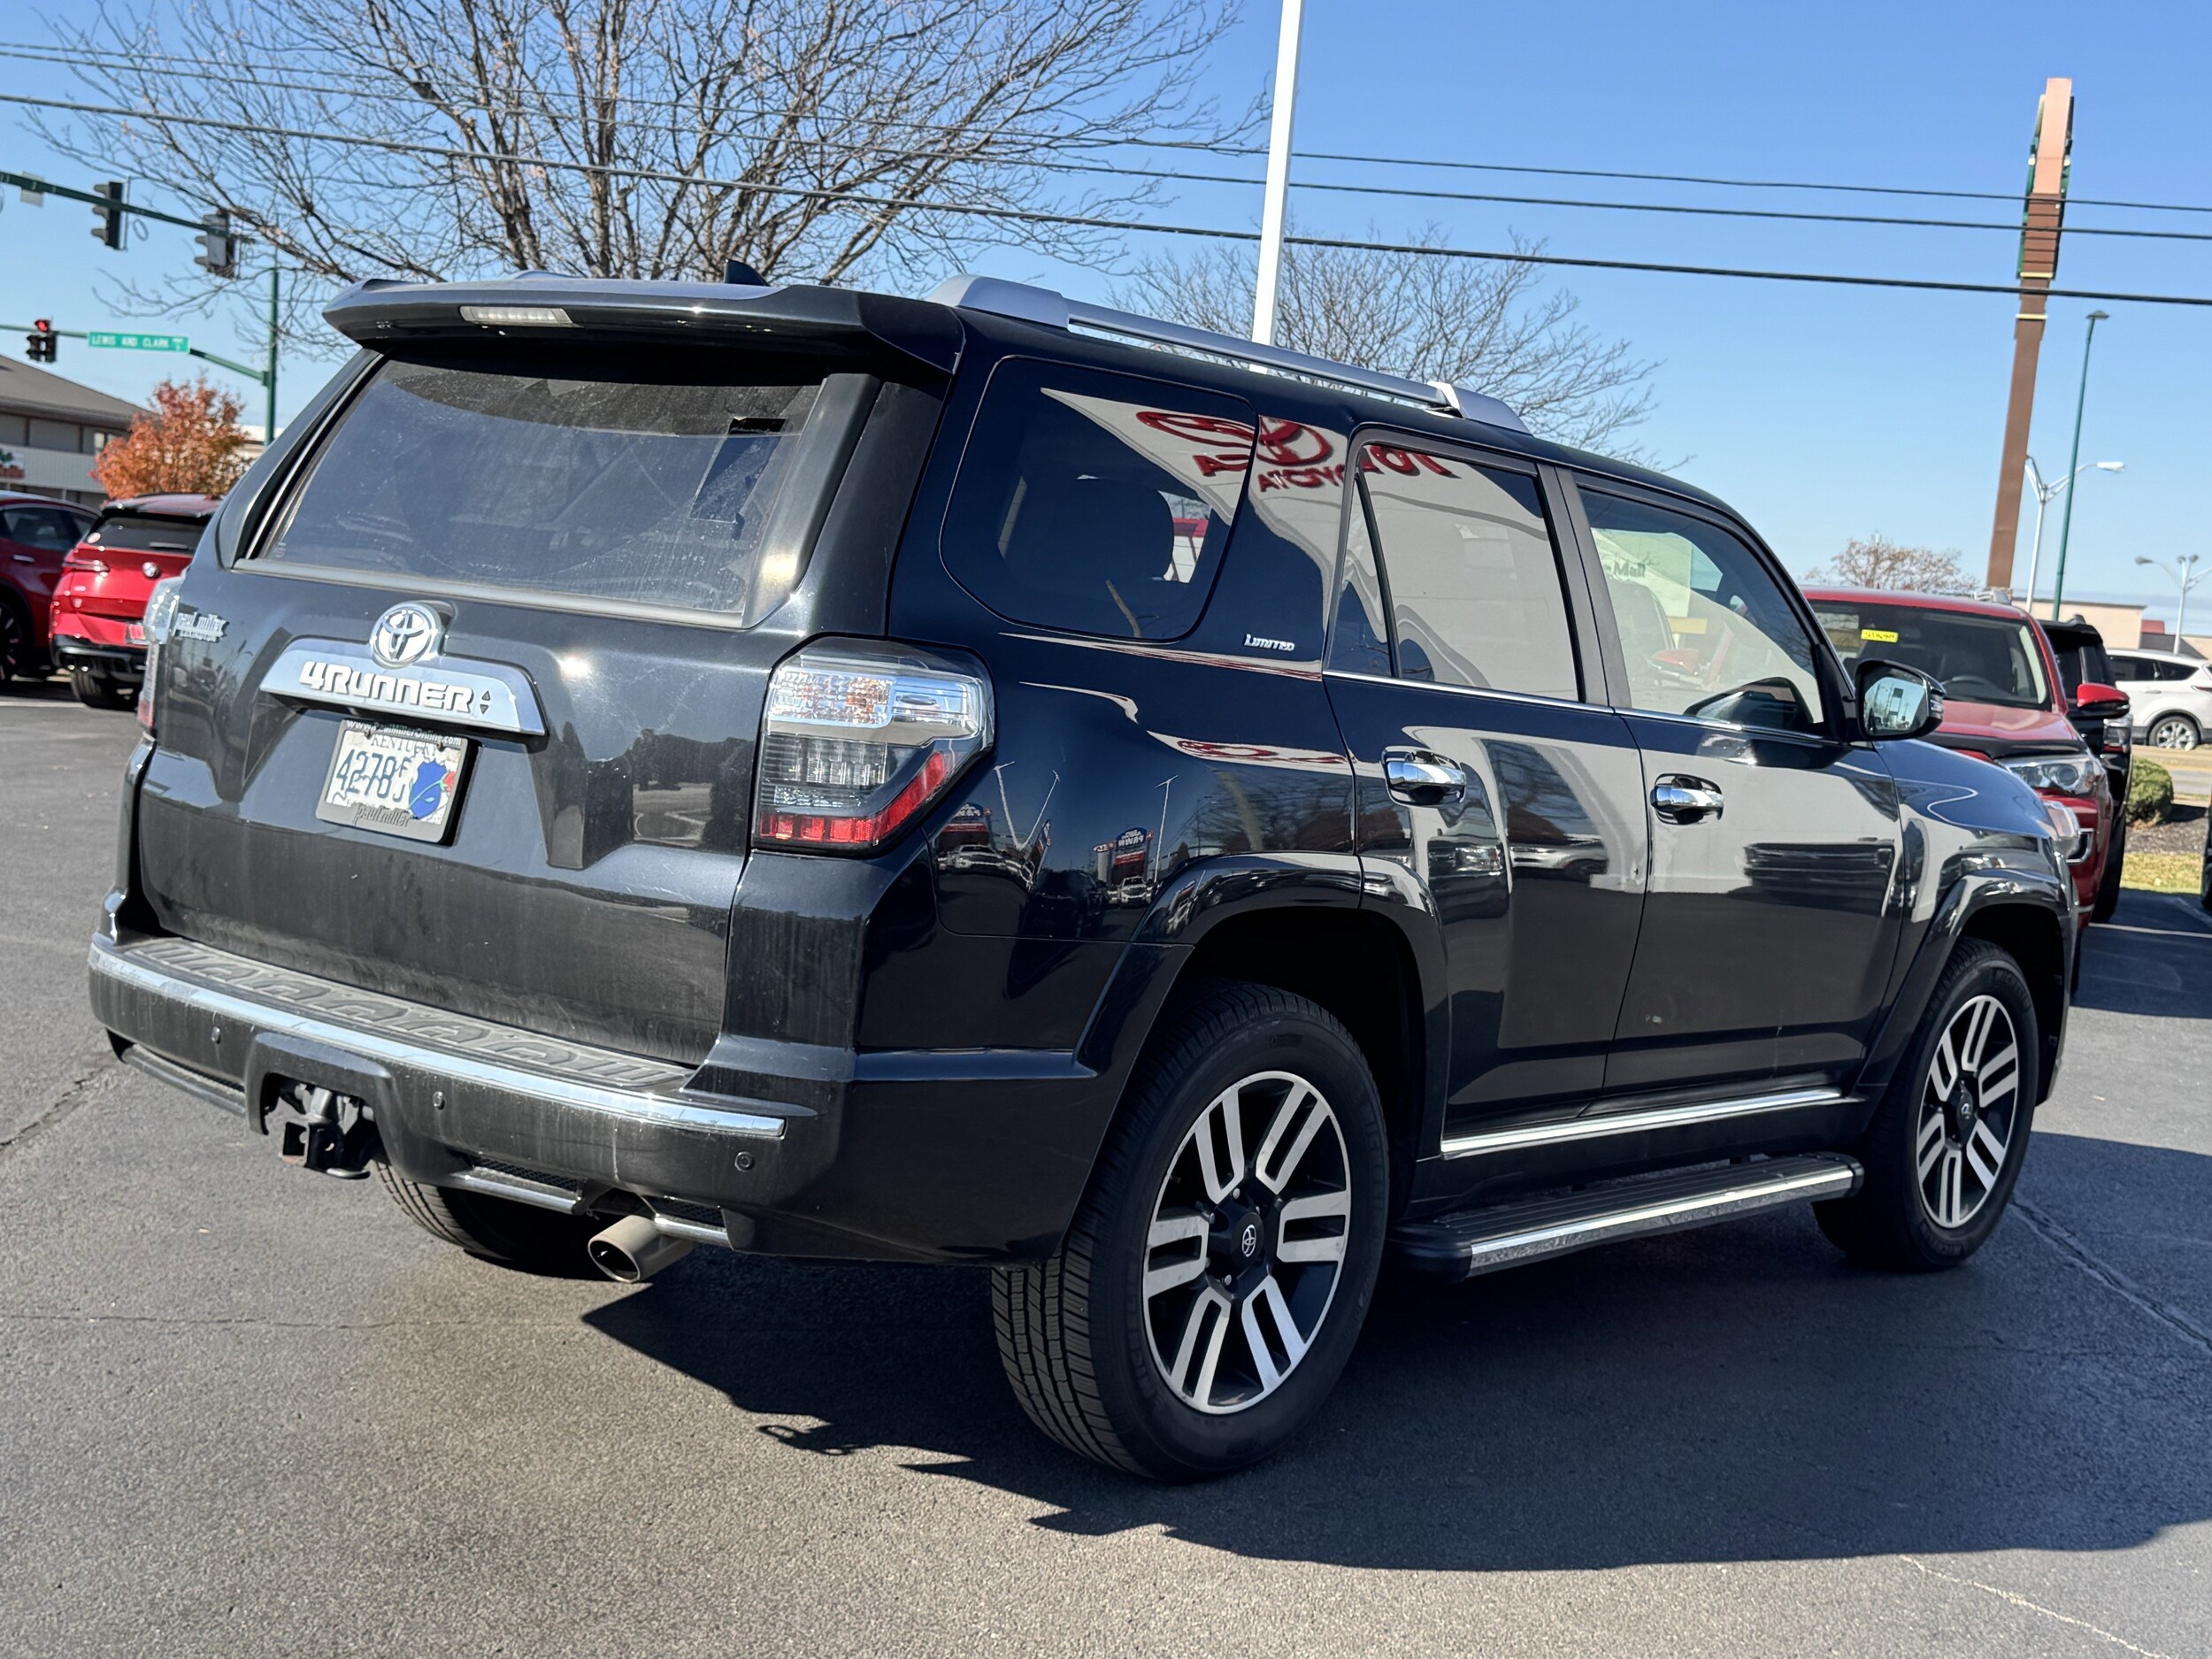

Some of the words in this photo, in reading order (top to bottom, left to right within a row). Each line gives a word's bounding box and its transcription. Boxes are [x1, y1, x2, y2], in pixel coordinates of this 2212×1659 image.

[91, 334, 116, 346] LEWIS
[121, 336, 139, 348] AND
[142, 337, 170, 349] CLARK
[299, 661, 474, 713] 4RUNNER
[371, 733, 437, 757] KENTUCKY
